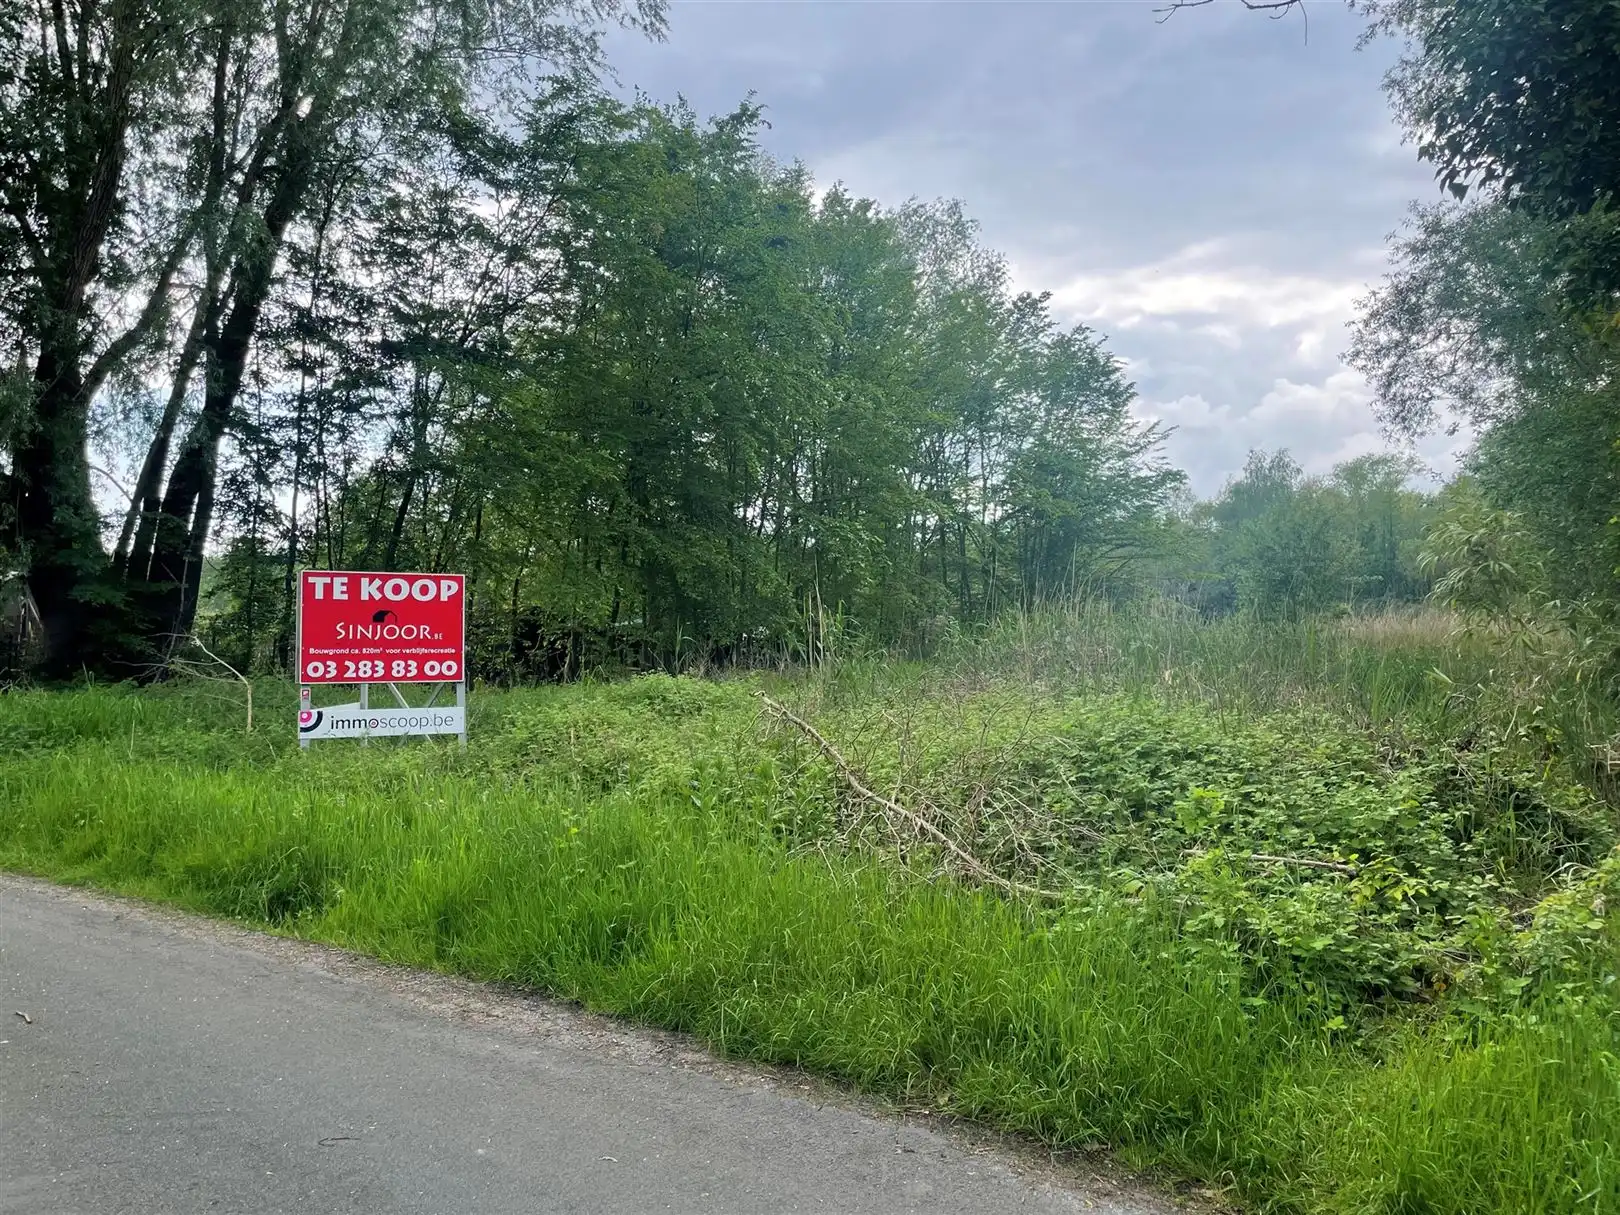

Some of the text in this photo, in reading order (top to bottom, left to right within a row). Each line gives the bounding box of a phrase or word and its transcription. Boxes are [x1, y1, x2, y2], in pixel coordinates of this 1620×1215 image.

[308, 577, 459, 601] TE KOOP
[336, 622, 443, 640] SINJOOR.BE
[309, 647, 350, 655] Bouwgrond
[402, 647, 456, 655] verblijfsrecreatie
[306, 660, 458, 679] 03 283 83 00
[330, 713, 454, 730] immoscoop.be
